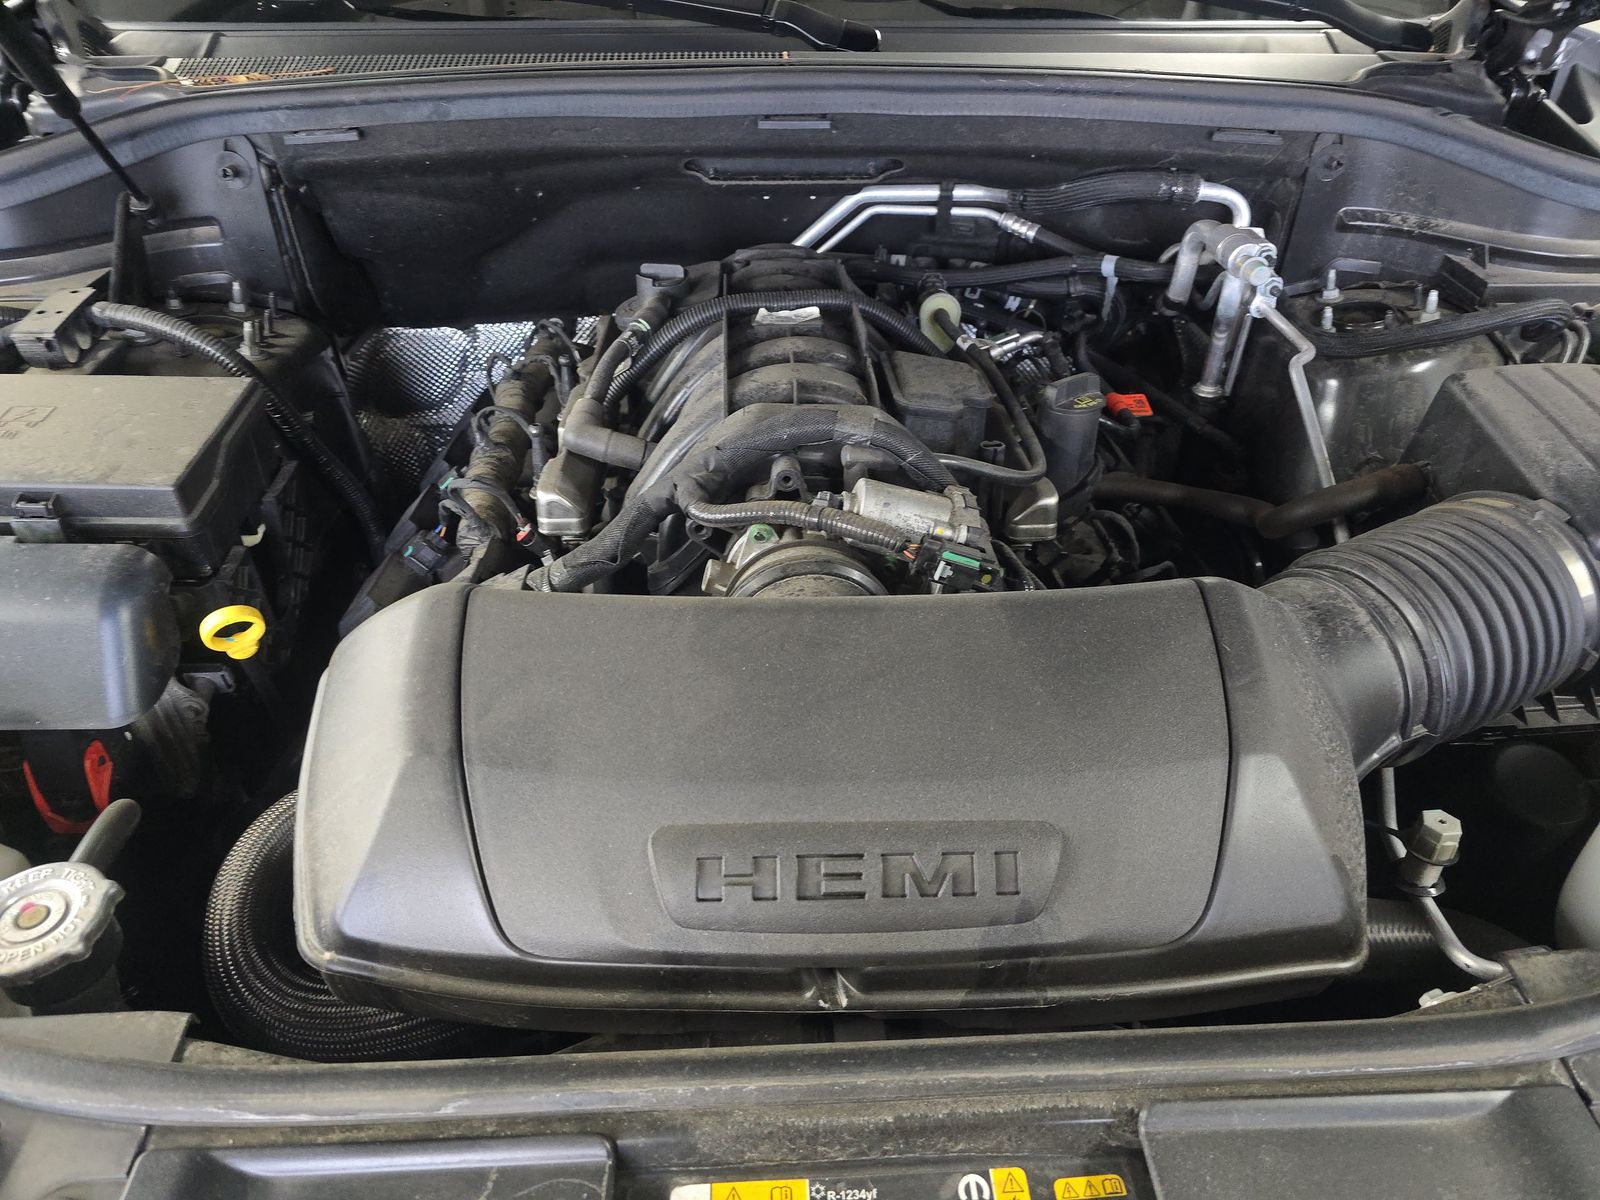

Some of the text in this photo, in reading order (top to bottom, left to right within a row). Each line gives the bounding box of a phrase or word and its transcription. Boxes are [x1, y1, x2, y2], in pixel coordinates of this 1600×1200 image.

[3, 868, 54, 894] KEEP
[696, 851, 1019, 901] HEMI
[826, 1188, 878, 1200] R-1234yf
